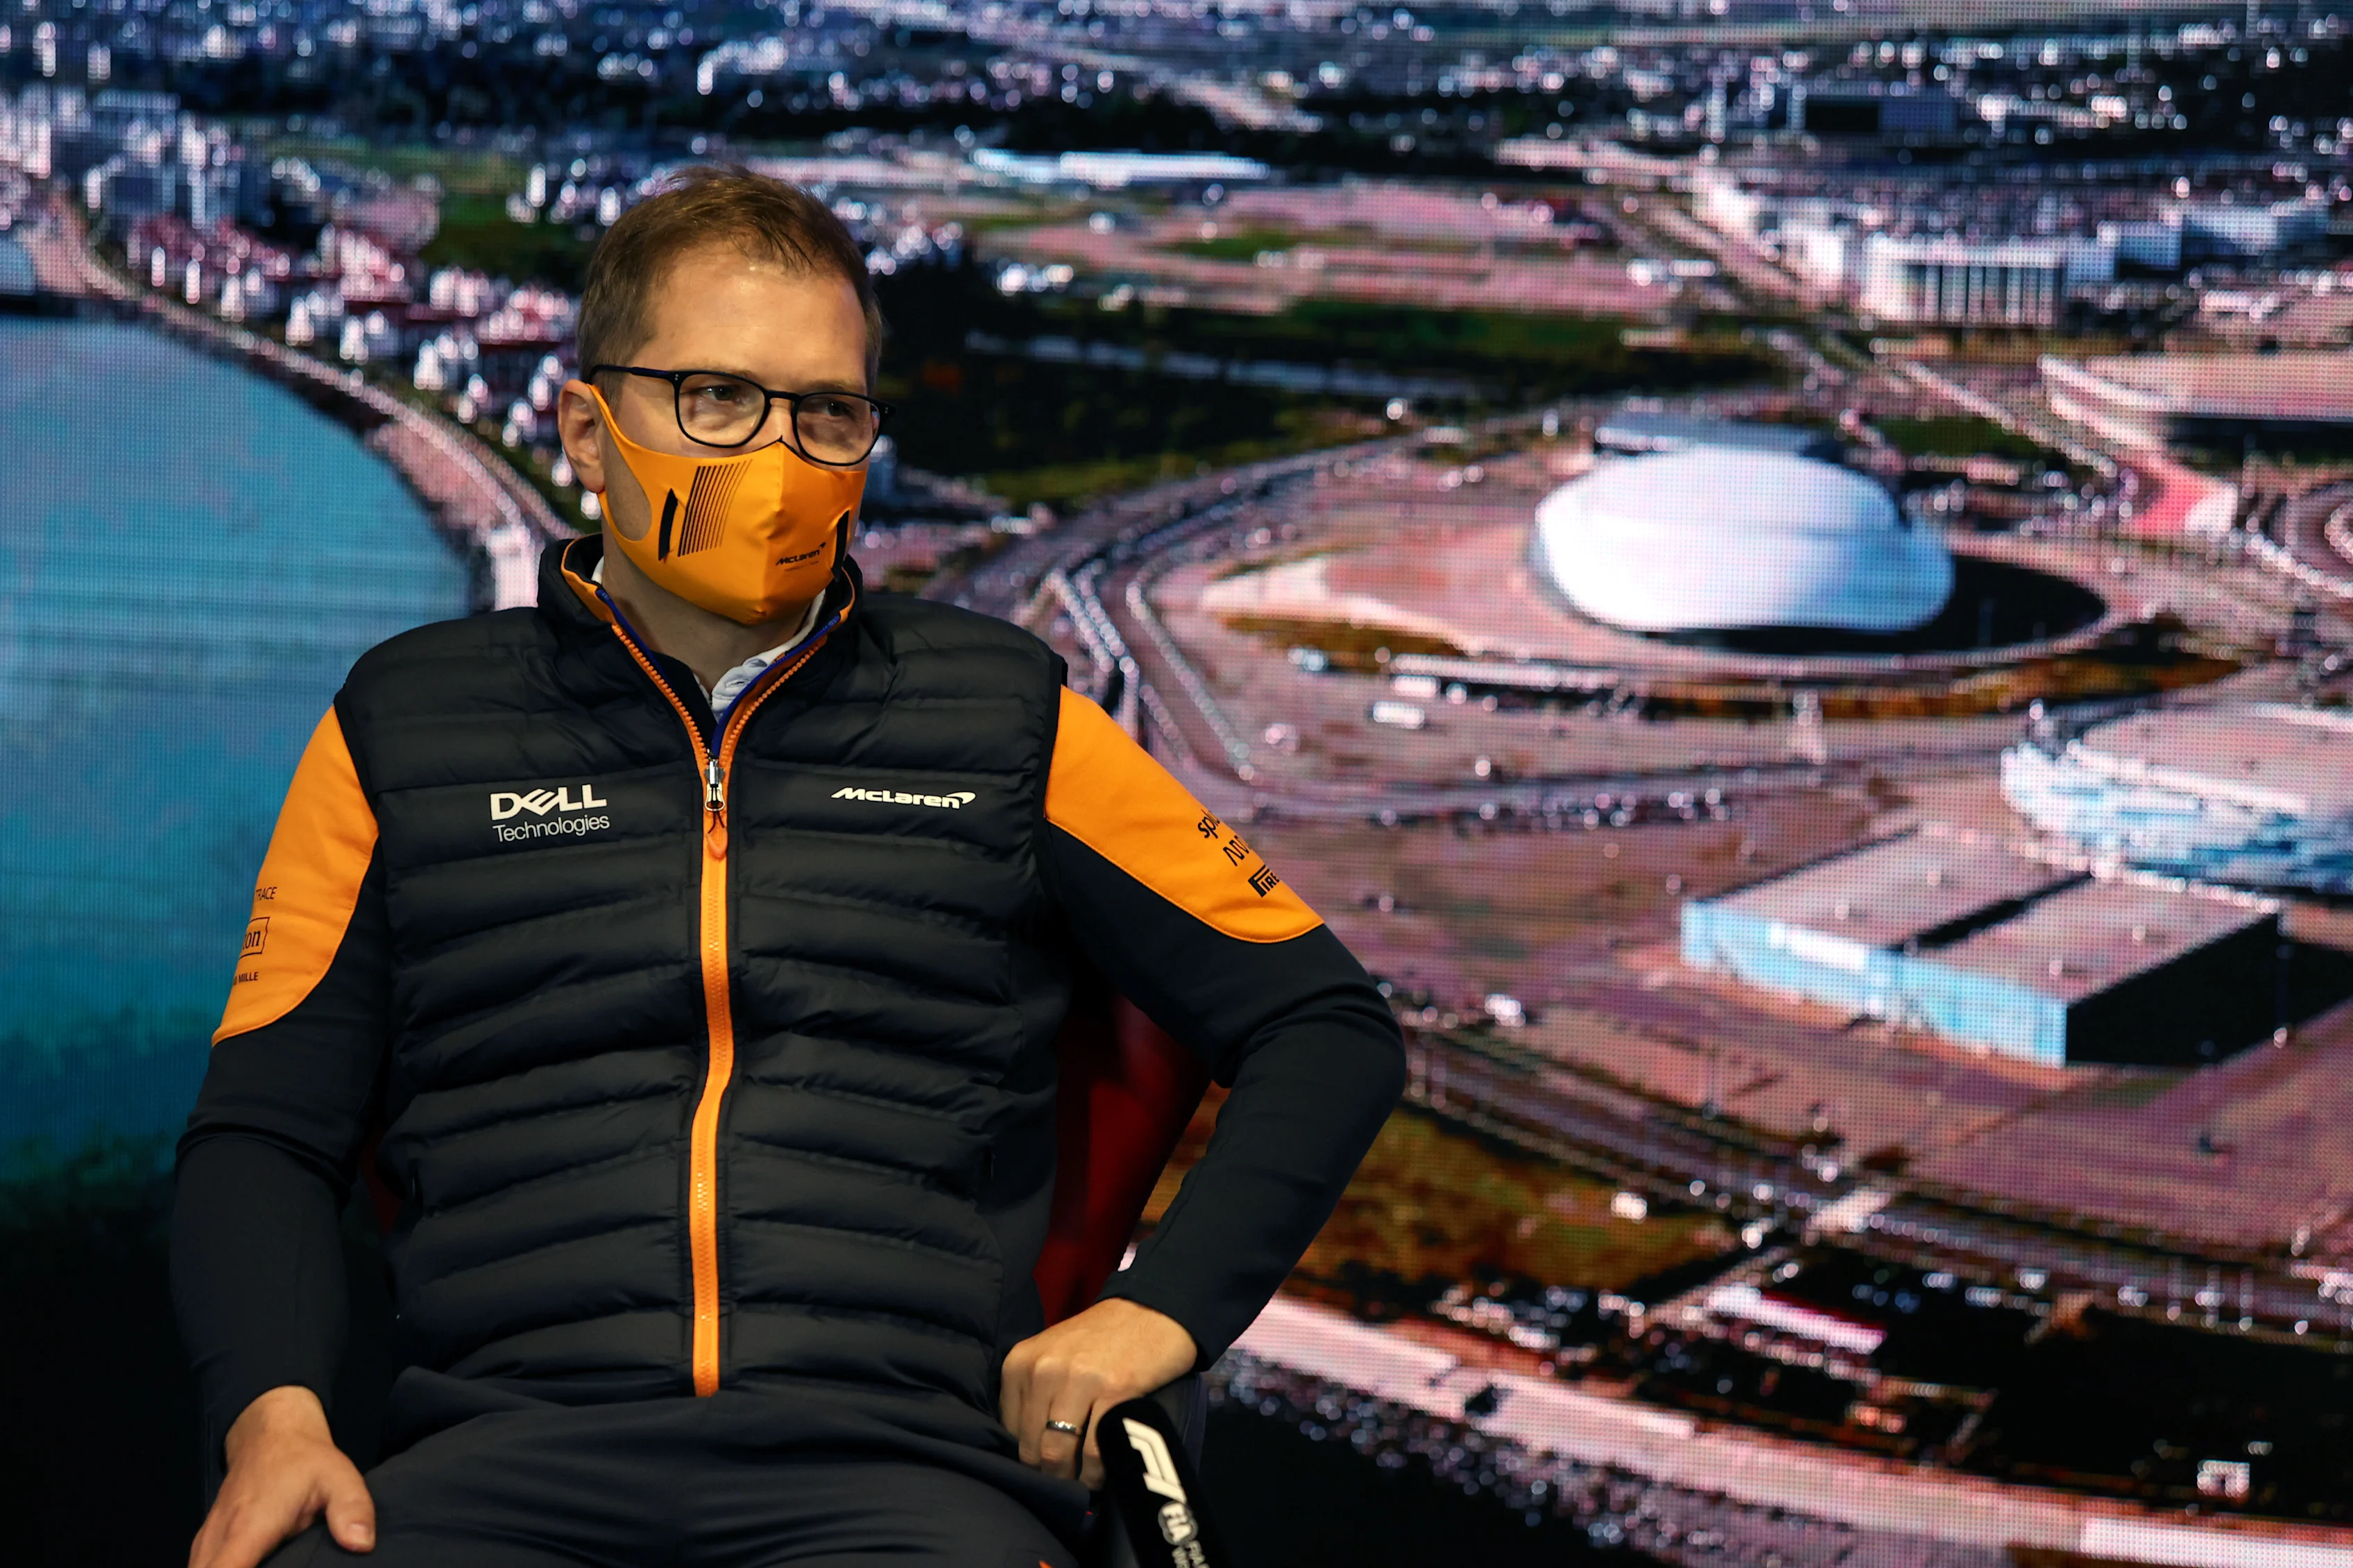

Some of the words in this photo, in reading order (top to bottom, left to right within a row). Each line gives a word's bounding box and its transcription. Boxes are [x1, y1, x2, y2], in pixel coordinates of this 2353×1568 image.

[490, 784, 608, 820] DELL
[831, 787, 961, 809] McLaren
[493, 814, 610, 842] Technologies
[242, 930, 261, 950] on
[238, 972, 259, 983] MILLE
